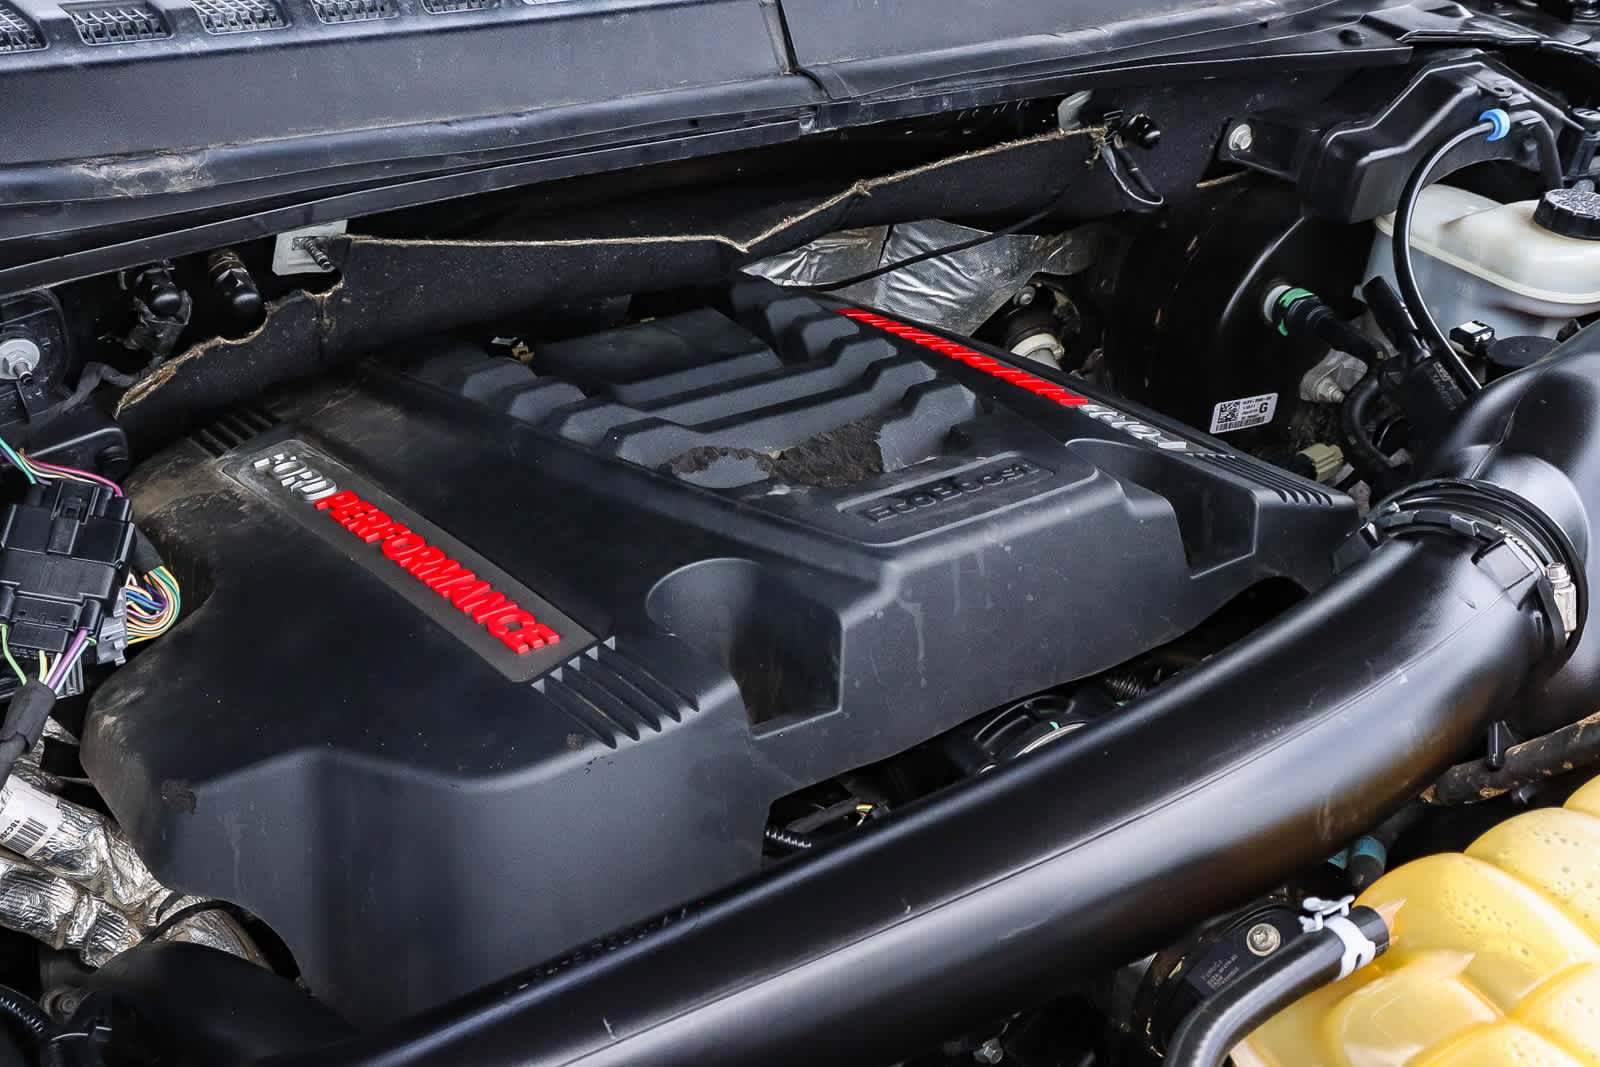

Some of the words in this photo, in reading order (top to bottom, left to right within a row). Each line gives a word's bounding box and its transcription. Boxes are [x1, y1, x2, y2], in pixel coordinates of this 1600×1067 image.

[1259, 402, 1269, 413] G
[253, 453, 338, 501] FORD
[313, 490, 560, 654] PERFORMANCE
